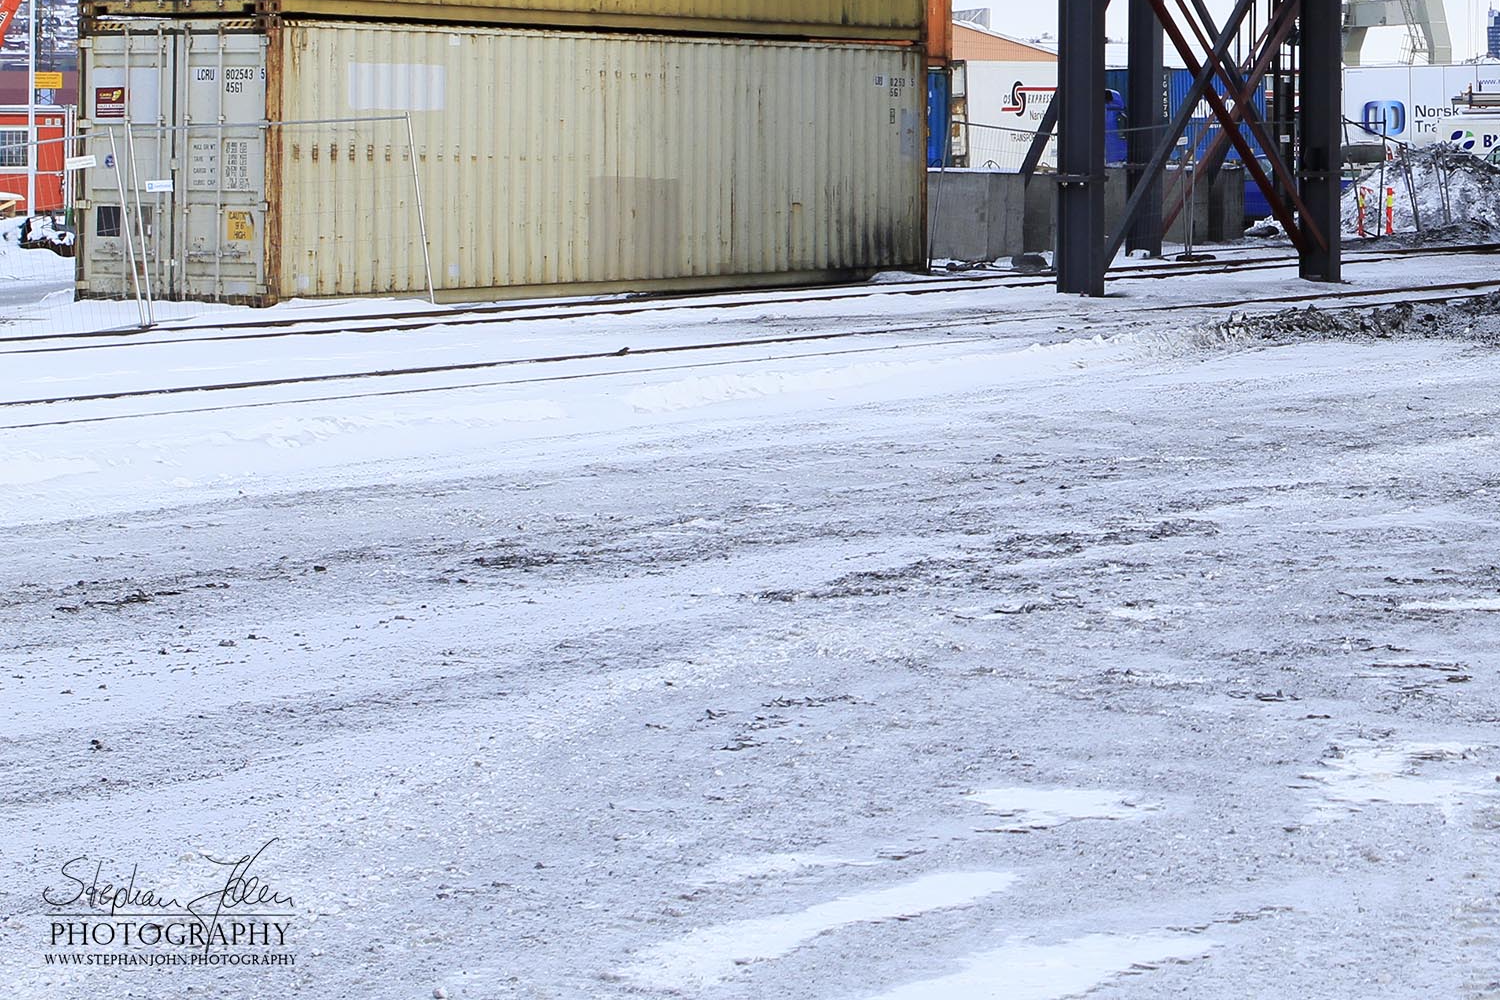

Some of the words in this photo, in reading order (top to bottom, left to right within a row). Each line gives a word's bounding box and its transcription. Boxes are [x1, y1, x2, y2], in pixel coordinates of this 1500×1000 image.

[226, 68, 254, 80] 802543
[226, 82, 243, 93] 45G1
[1415, 105, 1460, 118] Norsk
